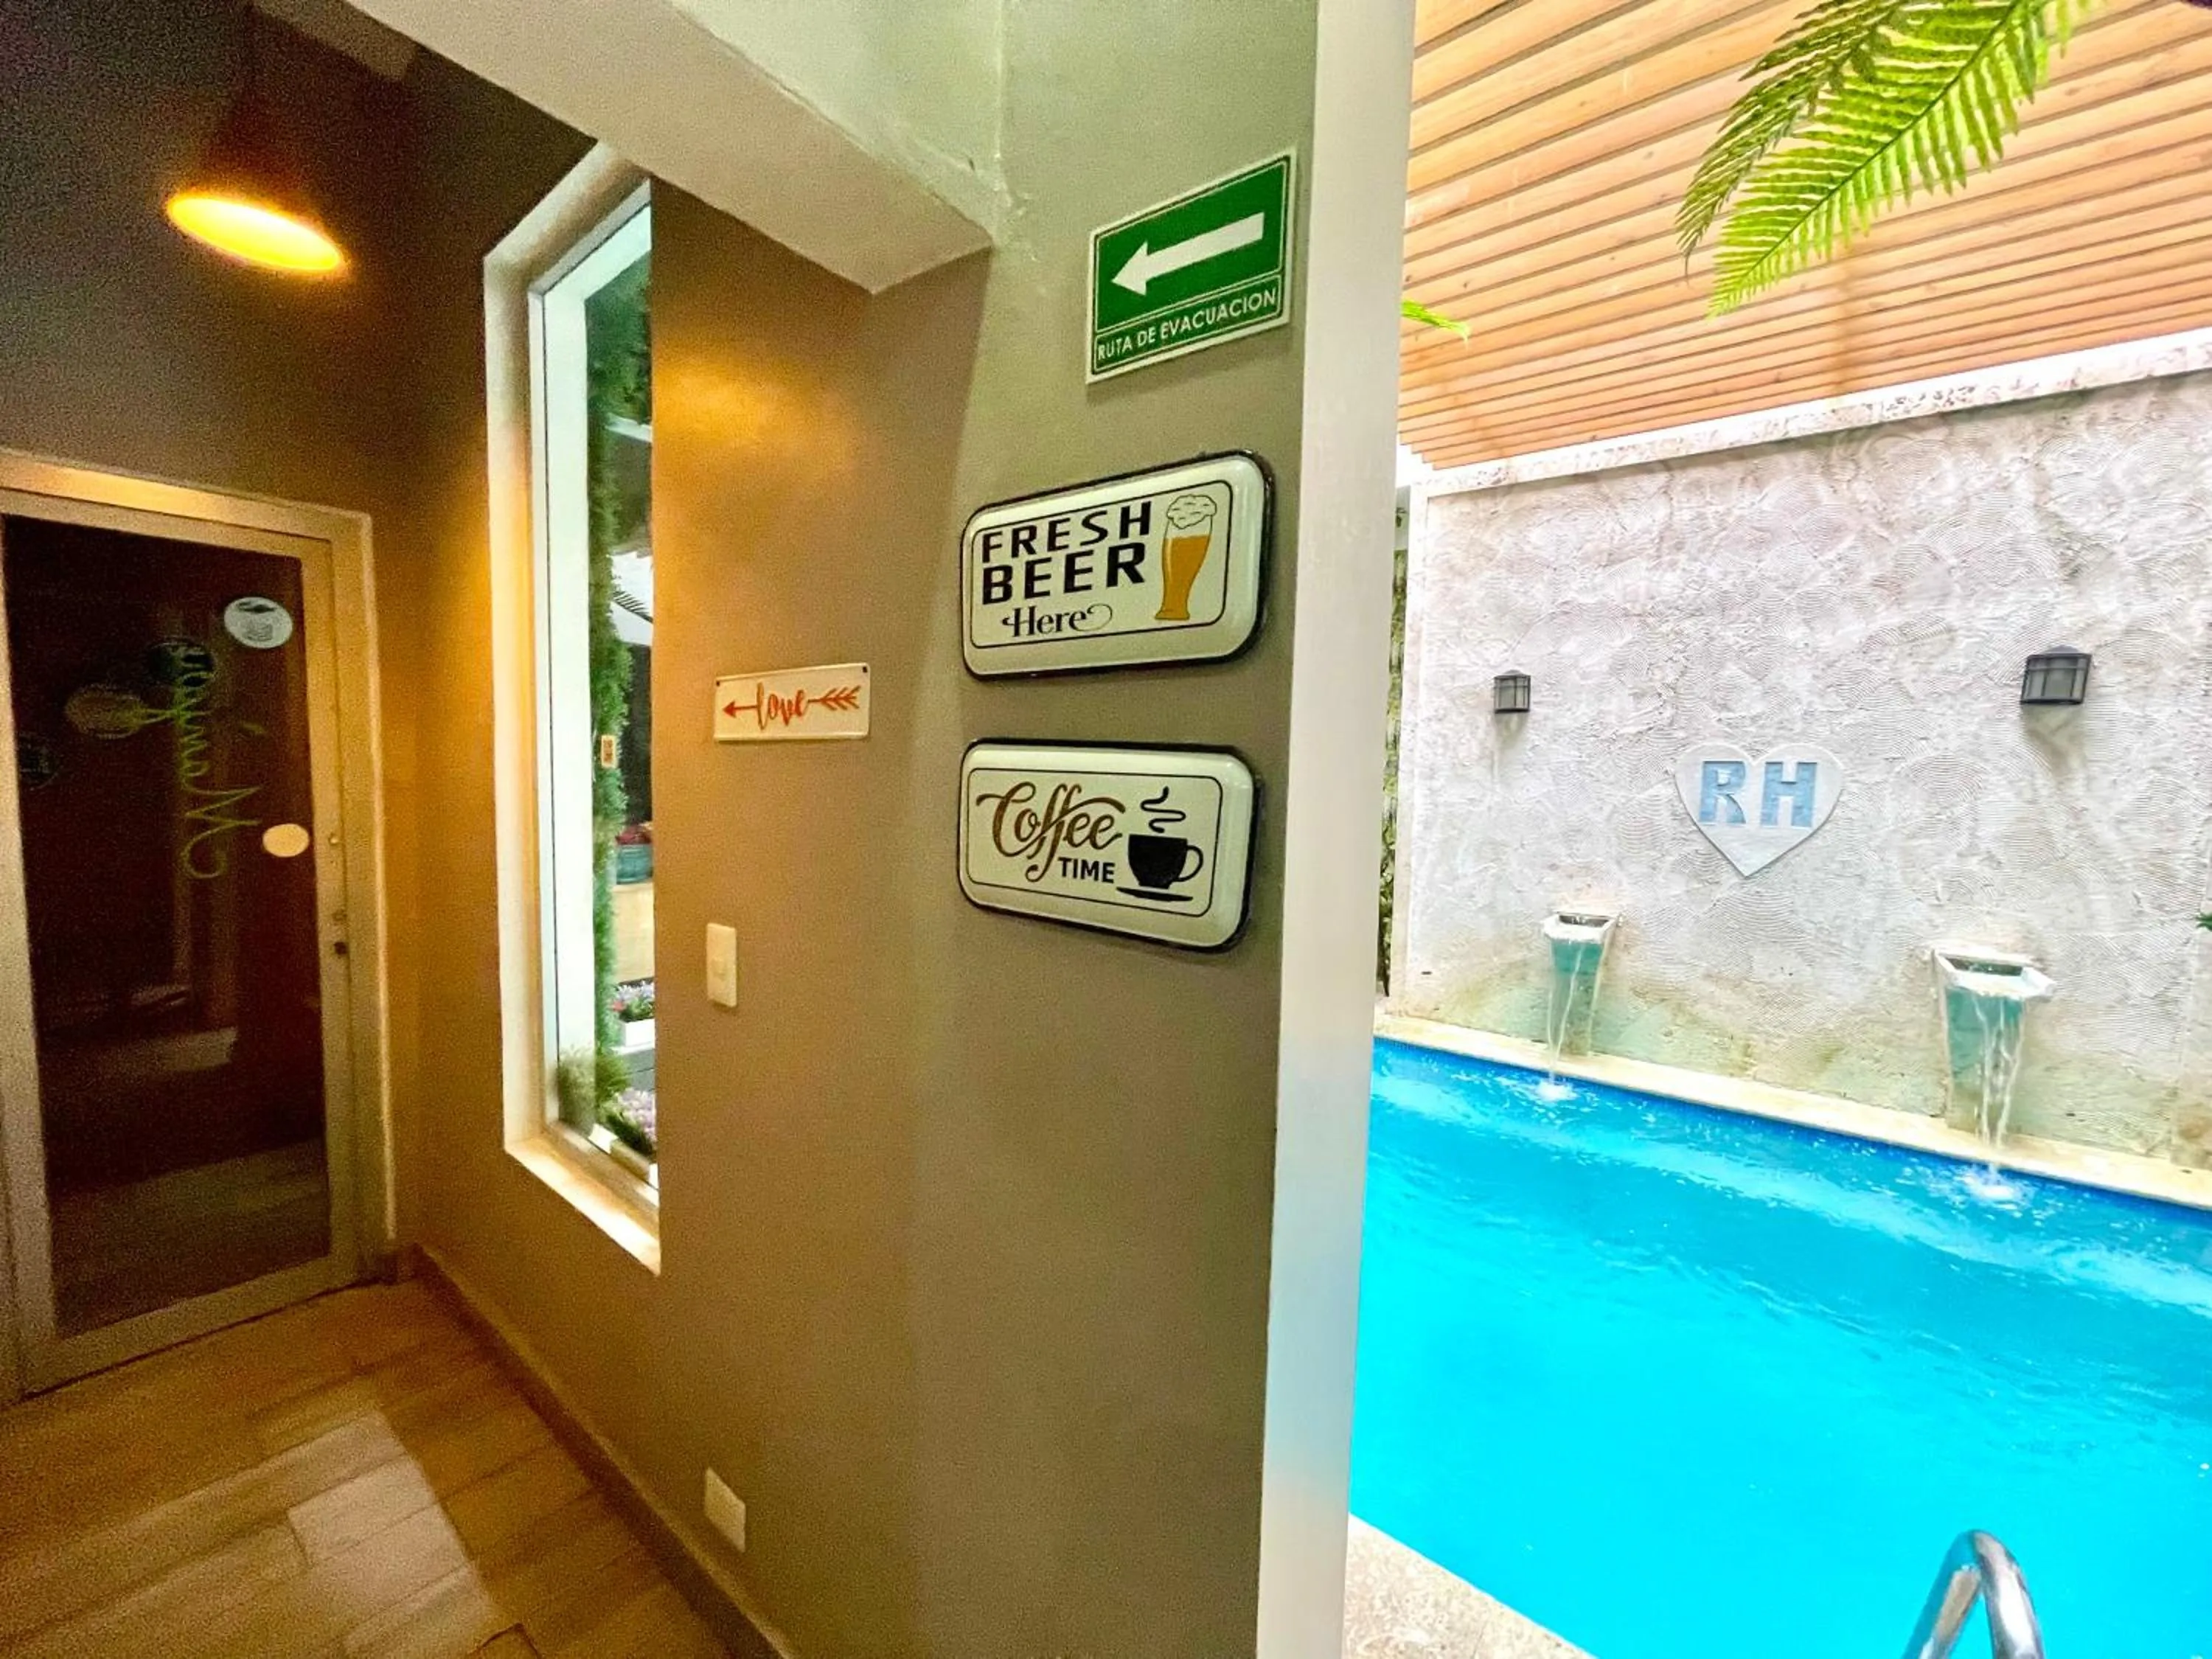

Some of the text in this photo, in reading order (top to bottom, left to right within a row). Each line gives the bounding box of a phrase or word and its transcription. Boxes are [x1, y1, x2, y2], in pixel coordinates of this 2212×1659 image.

[1097, 287, 1277, 361] RUTA DE EVACUACION
[981, 501, 1152, 563] FRESH
[982, 541, 1147, 605] BEER
[1002, 602, 1113, 638] Here
[756, 681, 809, 731] love
[1698, 760, 1818, 828] RH
[975, 781, 1126, 883] Coffee
[1057, 855, 1116, 884] TIME
